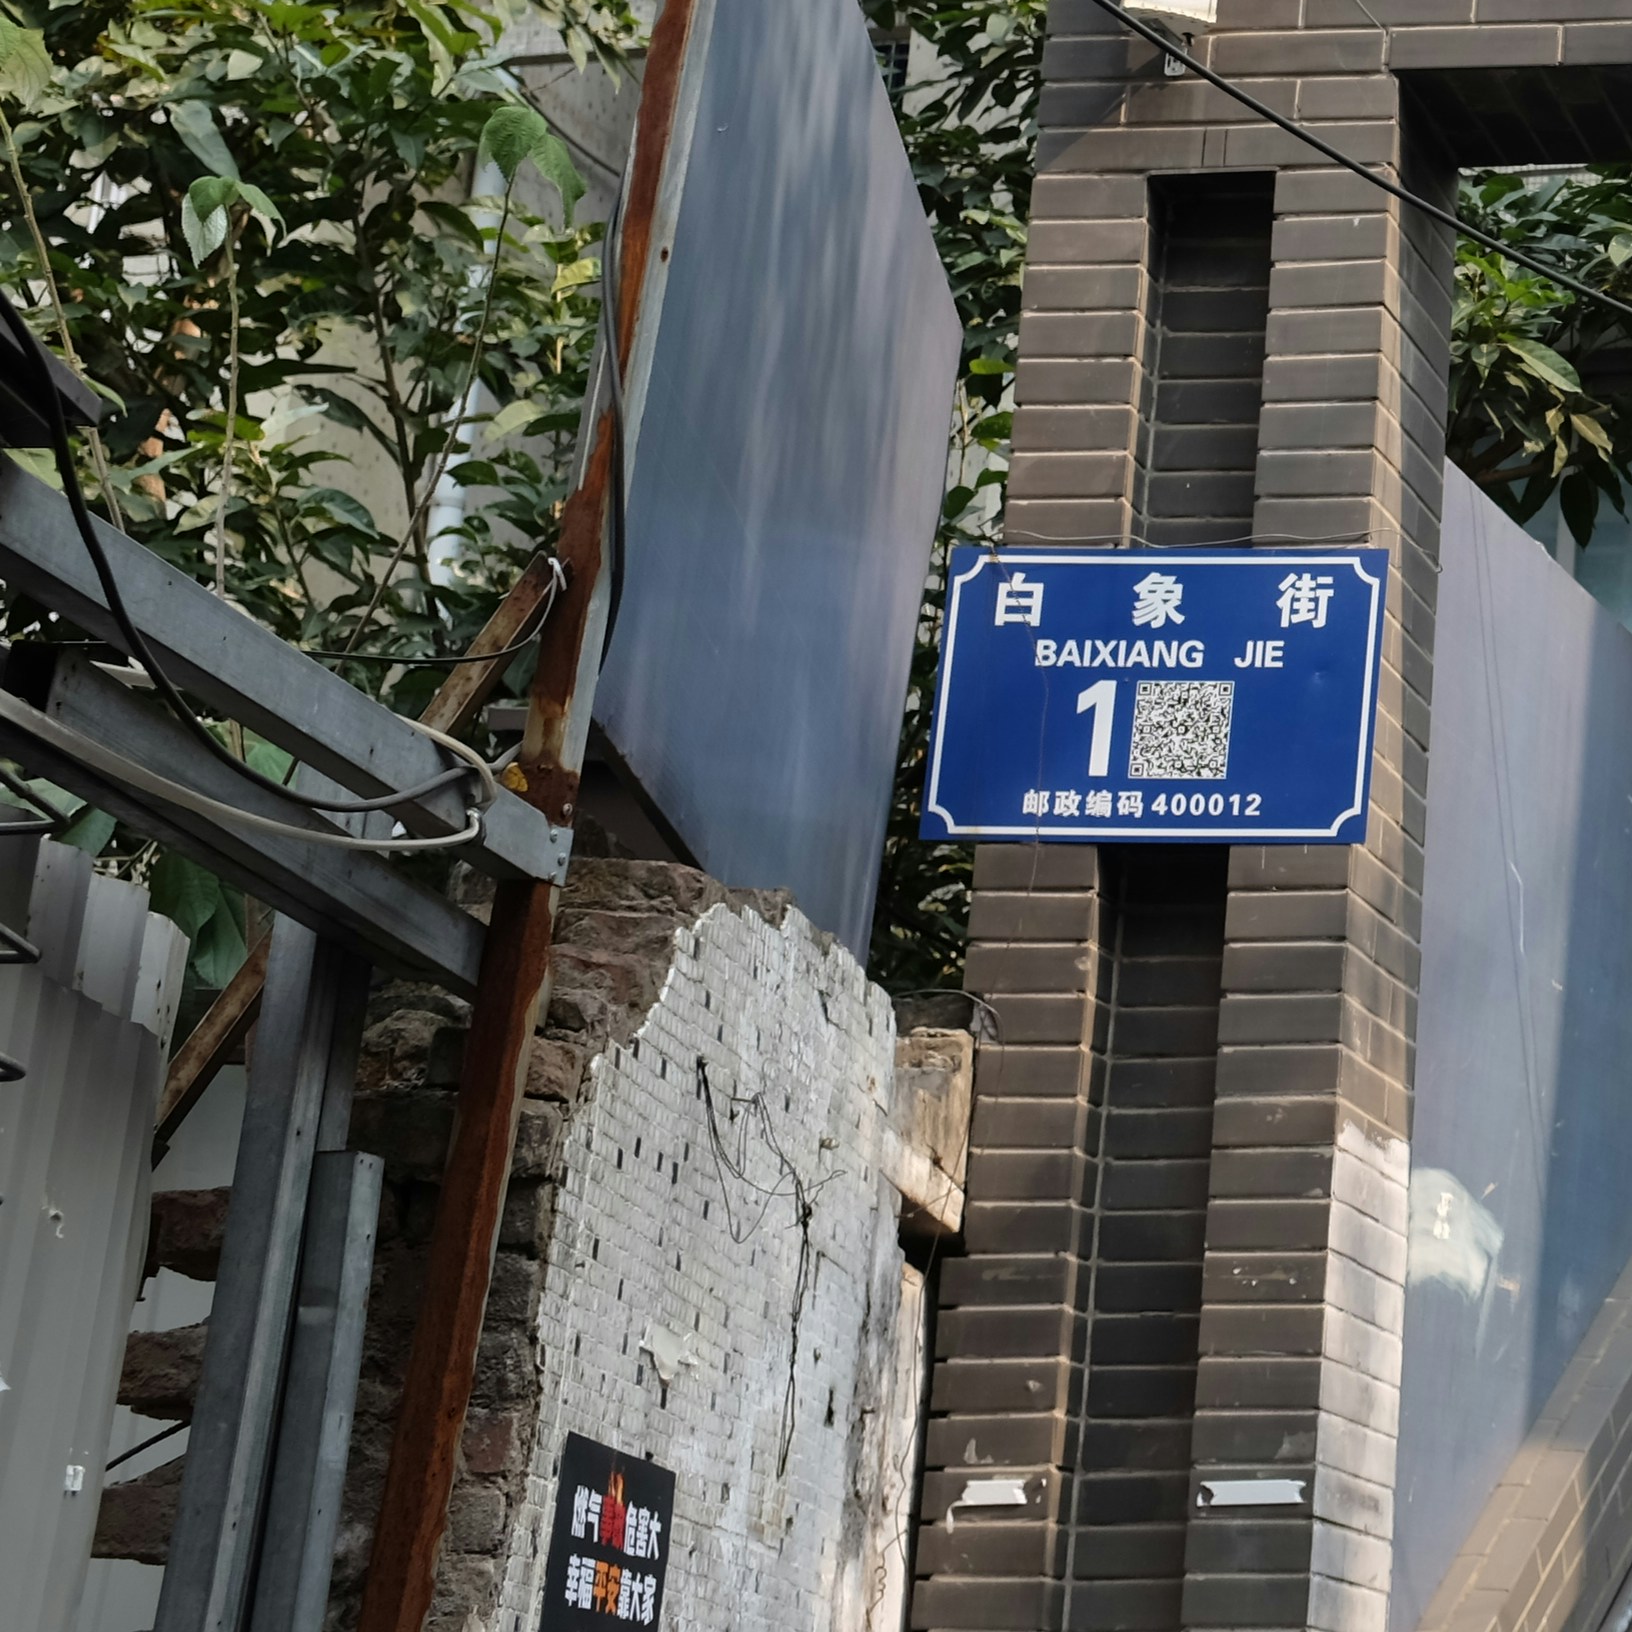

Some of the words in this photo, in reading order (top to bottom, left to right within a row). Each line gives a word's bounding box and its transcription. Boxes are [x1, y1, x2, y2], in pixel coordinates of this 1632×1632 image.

[994, 571, 1335, 629] 白象街
[1035, 639, 1205, 668] BAIXIANG
[1234, 640, 1284, 668] JIE
[1076, 679, 1117, 777] 1
[564, 1553, 657, 1626] 幸福平安靠大家
